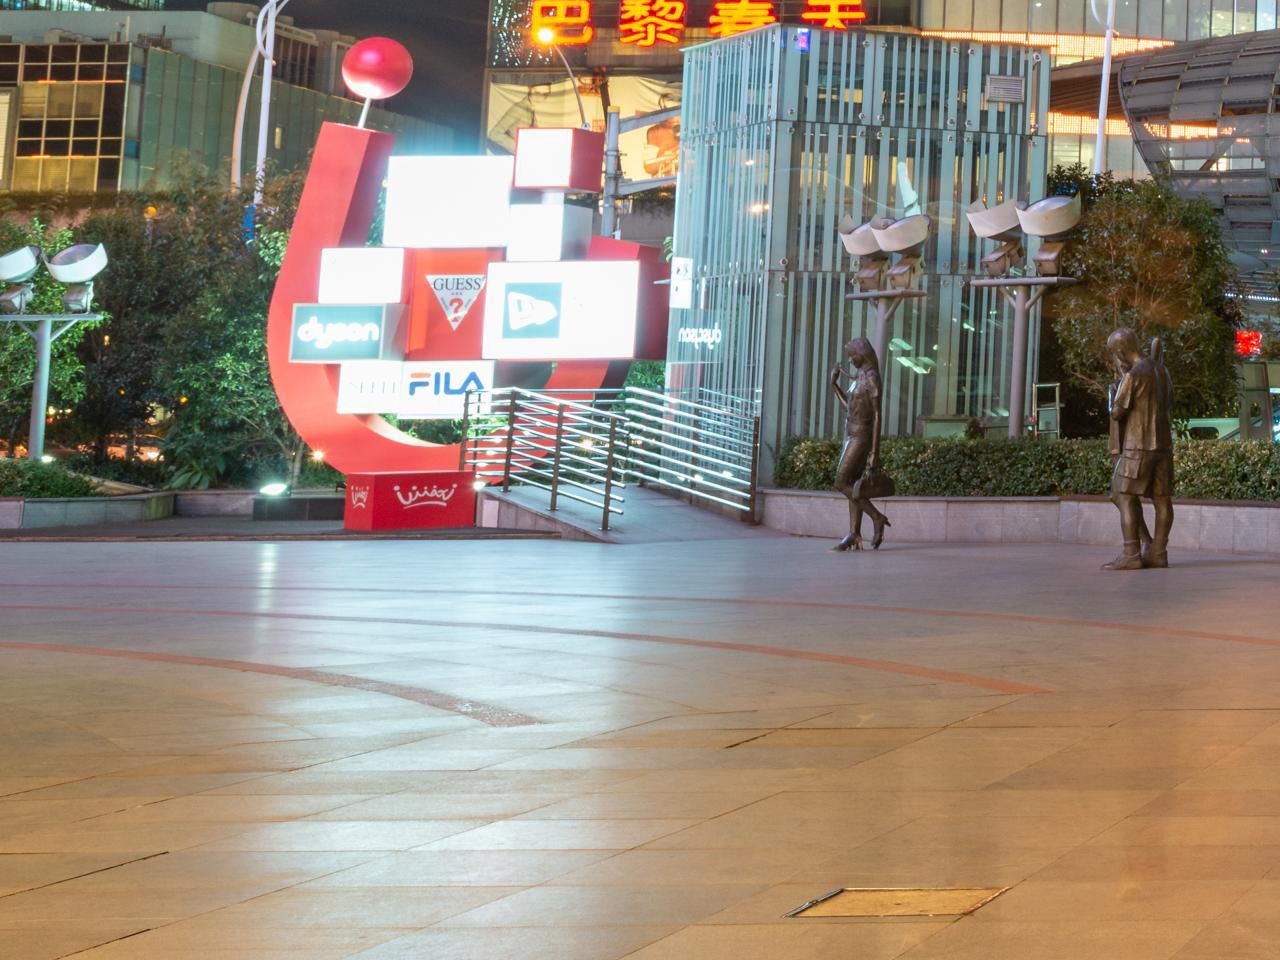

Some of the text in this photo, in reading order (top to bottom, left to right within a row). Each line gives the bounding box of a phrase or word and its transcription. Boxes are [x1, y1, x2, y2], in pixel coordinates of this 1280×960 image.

[433, 277, 482, 291] GUESS
[297, 316, 379, 349] dyson
[409, 371, 484, 396] FILA
